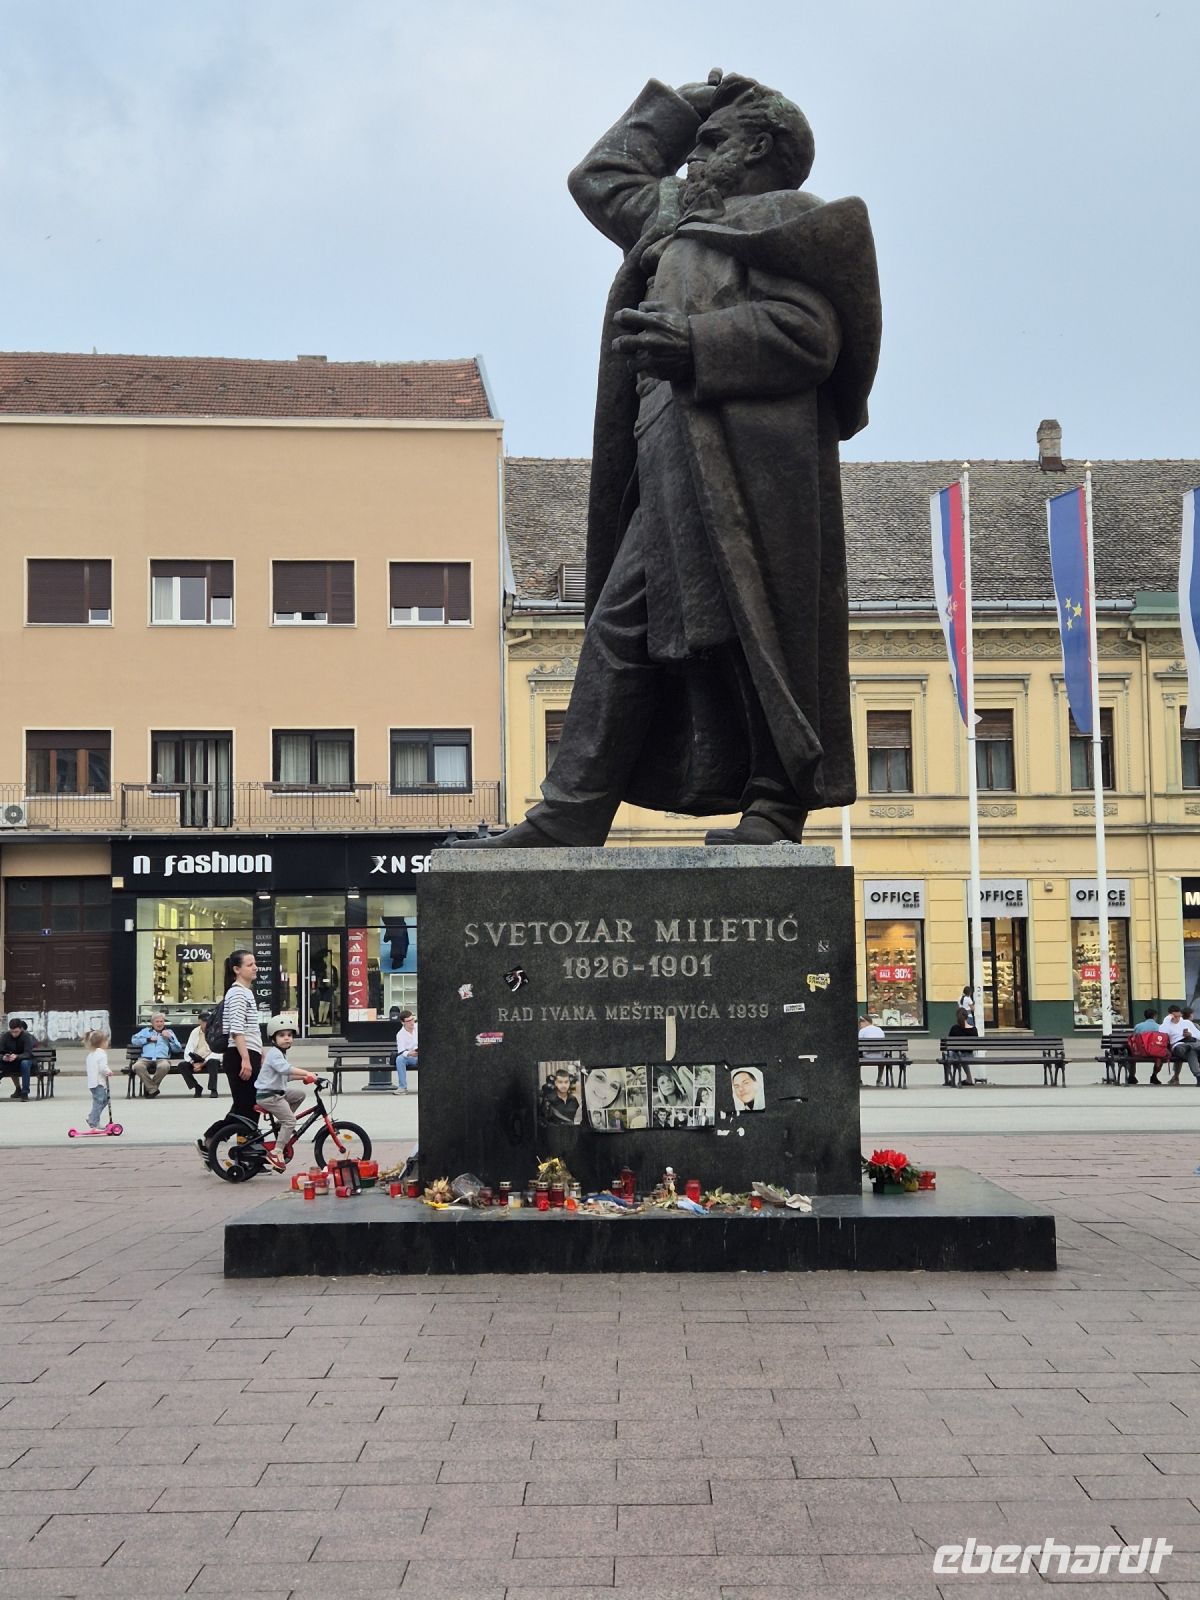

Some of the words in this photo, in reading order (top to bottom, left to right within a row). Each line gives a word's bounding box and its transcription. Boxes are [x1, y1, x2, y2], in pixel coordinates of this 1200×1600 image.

[133, 855, 151, 874] n
[164, 851, 272, 877] fashion
[391, 855, 406, 873] N
[870, 891, 920, 903] OFFICE
[1076, 890, 1126, 901] OFCE
[465, 917, 636, 947] SVETOZAR
[655, 913, 799, 943] MILETIĆ
[178, 948, 211, 960] -20%
[562, 954, 713, 979] 1826-1901
[498, 1007, 533, 1021] RAD
[541, 1005, 597, 1020] IVANA
[605, 1001, 721, 1021] MEŠTROVIĆA
[728, 1003, 769, 1019] 1939
